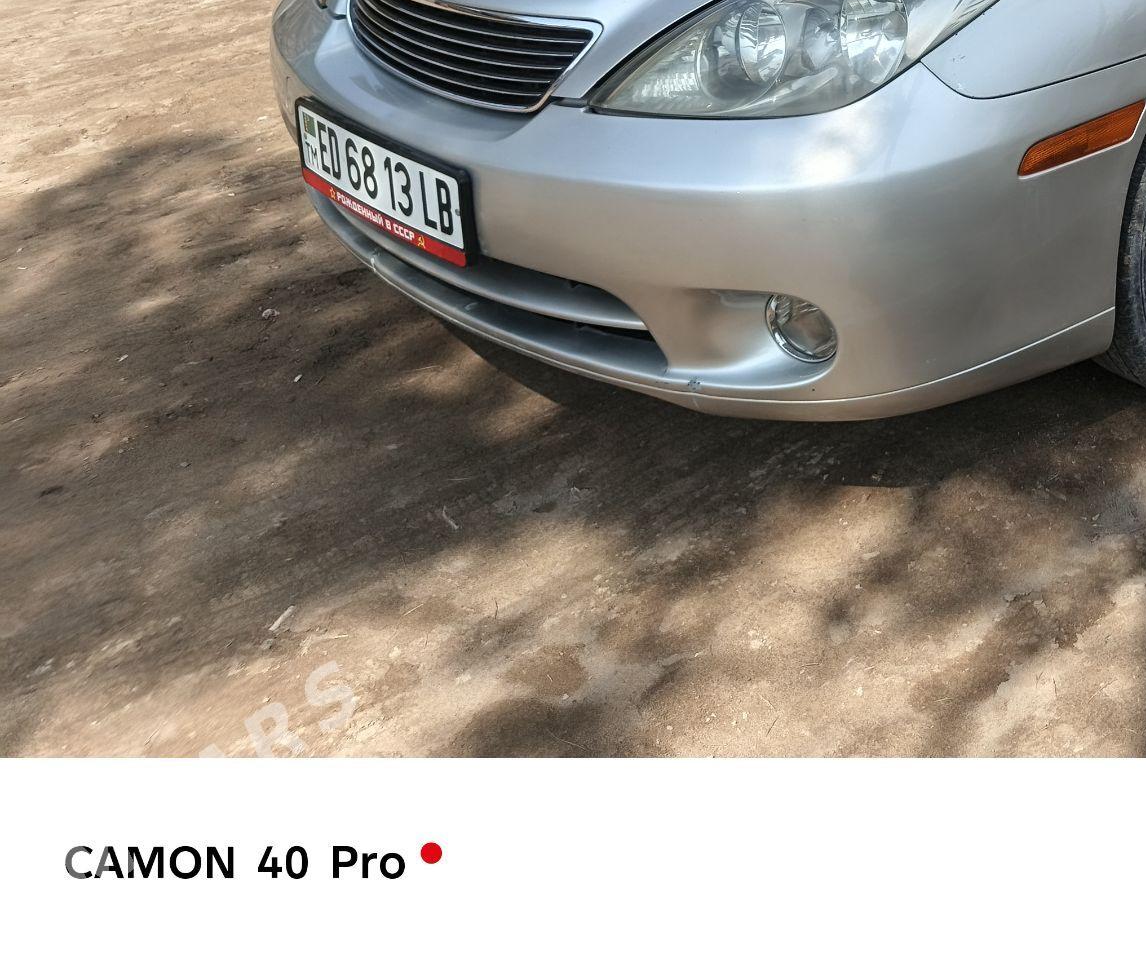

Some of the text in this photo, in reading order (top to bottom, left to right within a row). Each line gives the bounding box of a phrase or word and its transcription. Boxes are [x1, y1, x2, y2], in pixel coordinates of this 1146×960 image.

[316, 120, 454, 236] ED 68 13 LB
[393, 222, 415, 241] СССР
